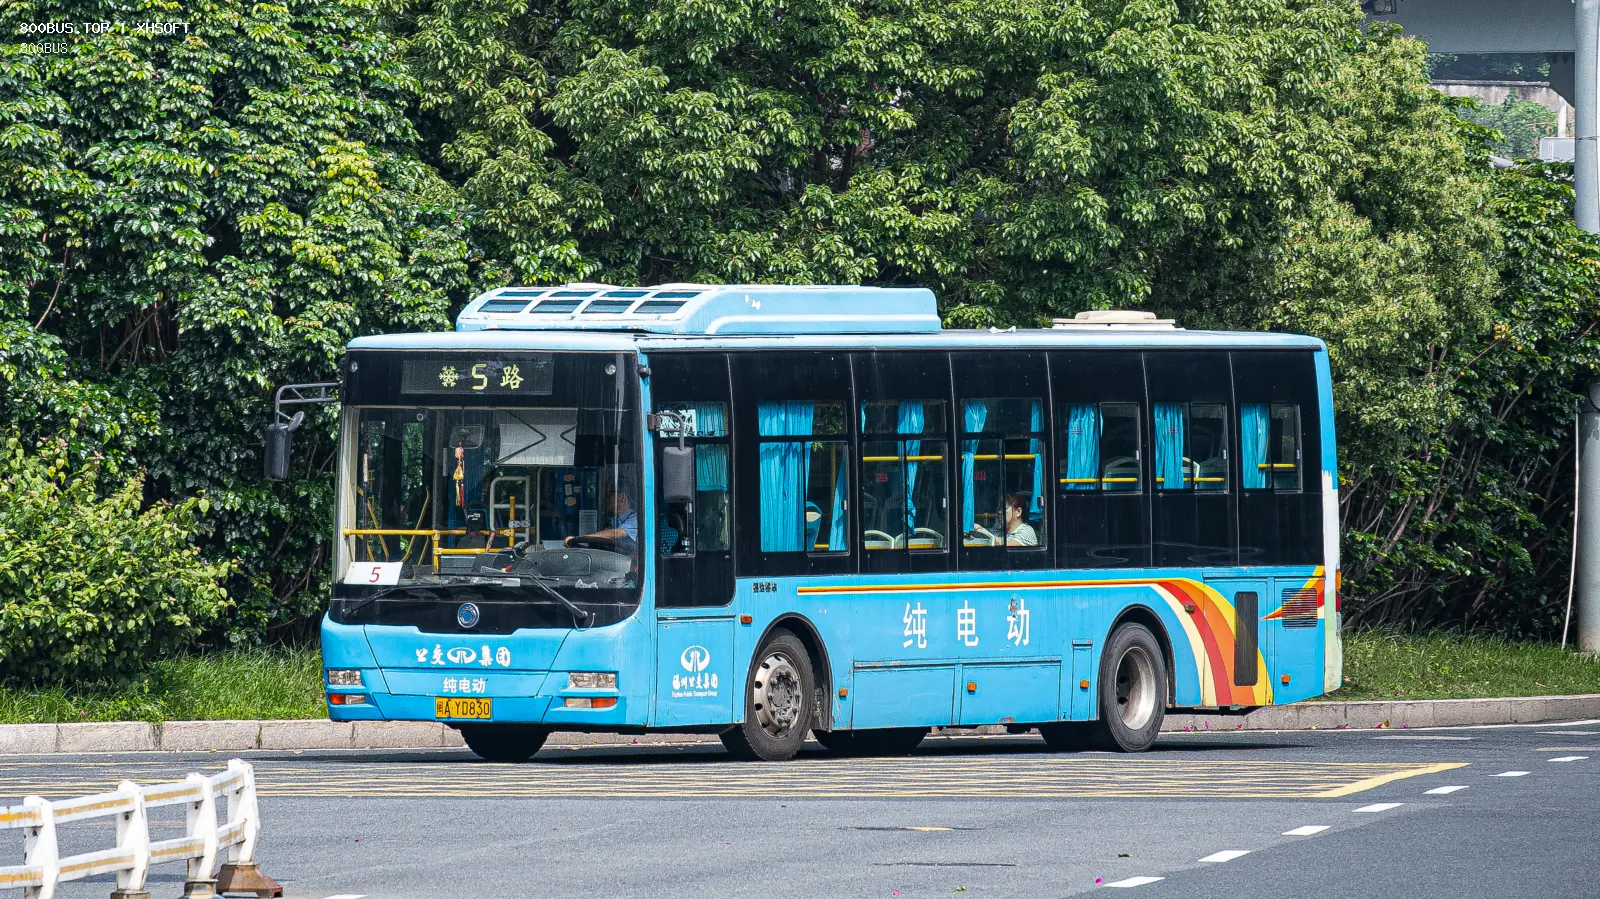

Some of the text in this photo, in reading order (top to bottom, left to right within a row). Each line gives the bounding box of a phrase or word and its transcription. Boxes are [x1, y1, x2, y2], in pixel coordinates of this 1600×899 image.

[471, 363, 525, 390] 5 路
[368, 566, 382, 583] 5
[902, 598, 1030, 649] 纯电动
[415, 643, 511, 667] 公交 集团
[442, 676, 486, 694] 纯电动
